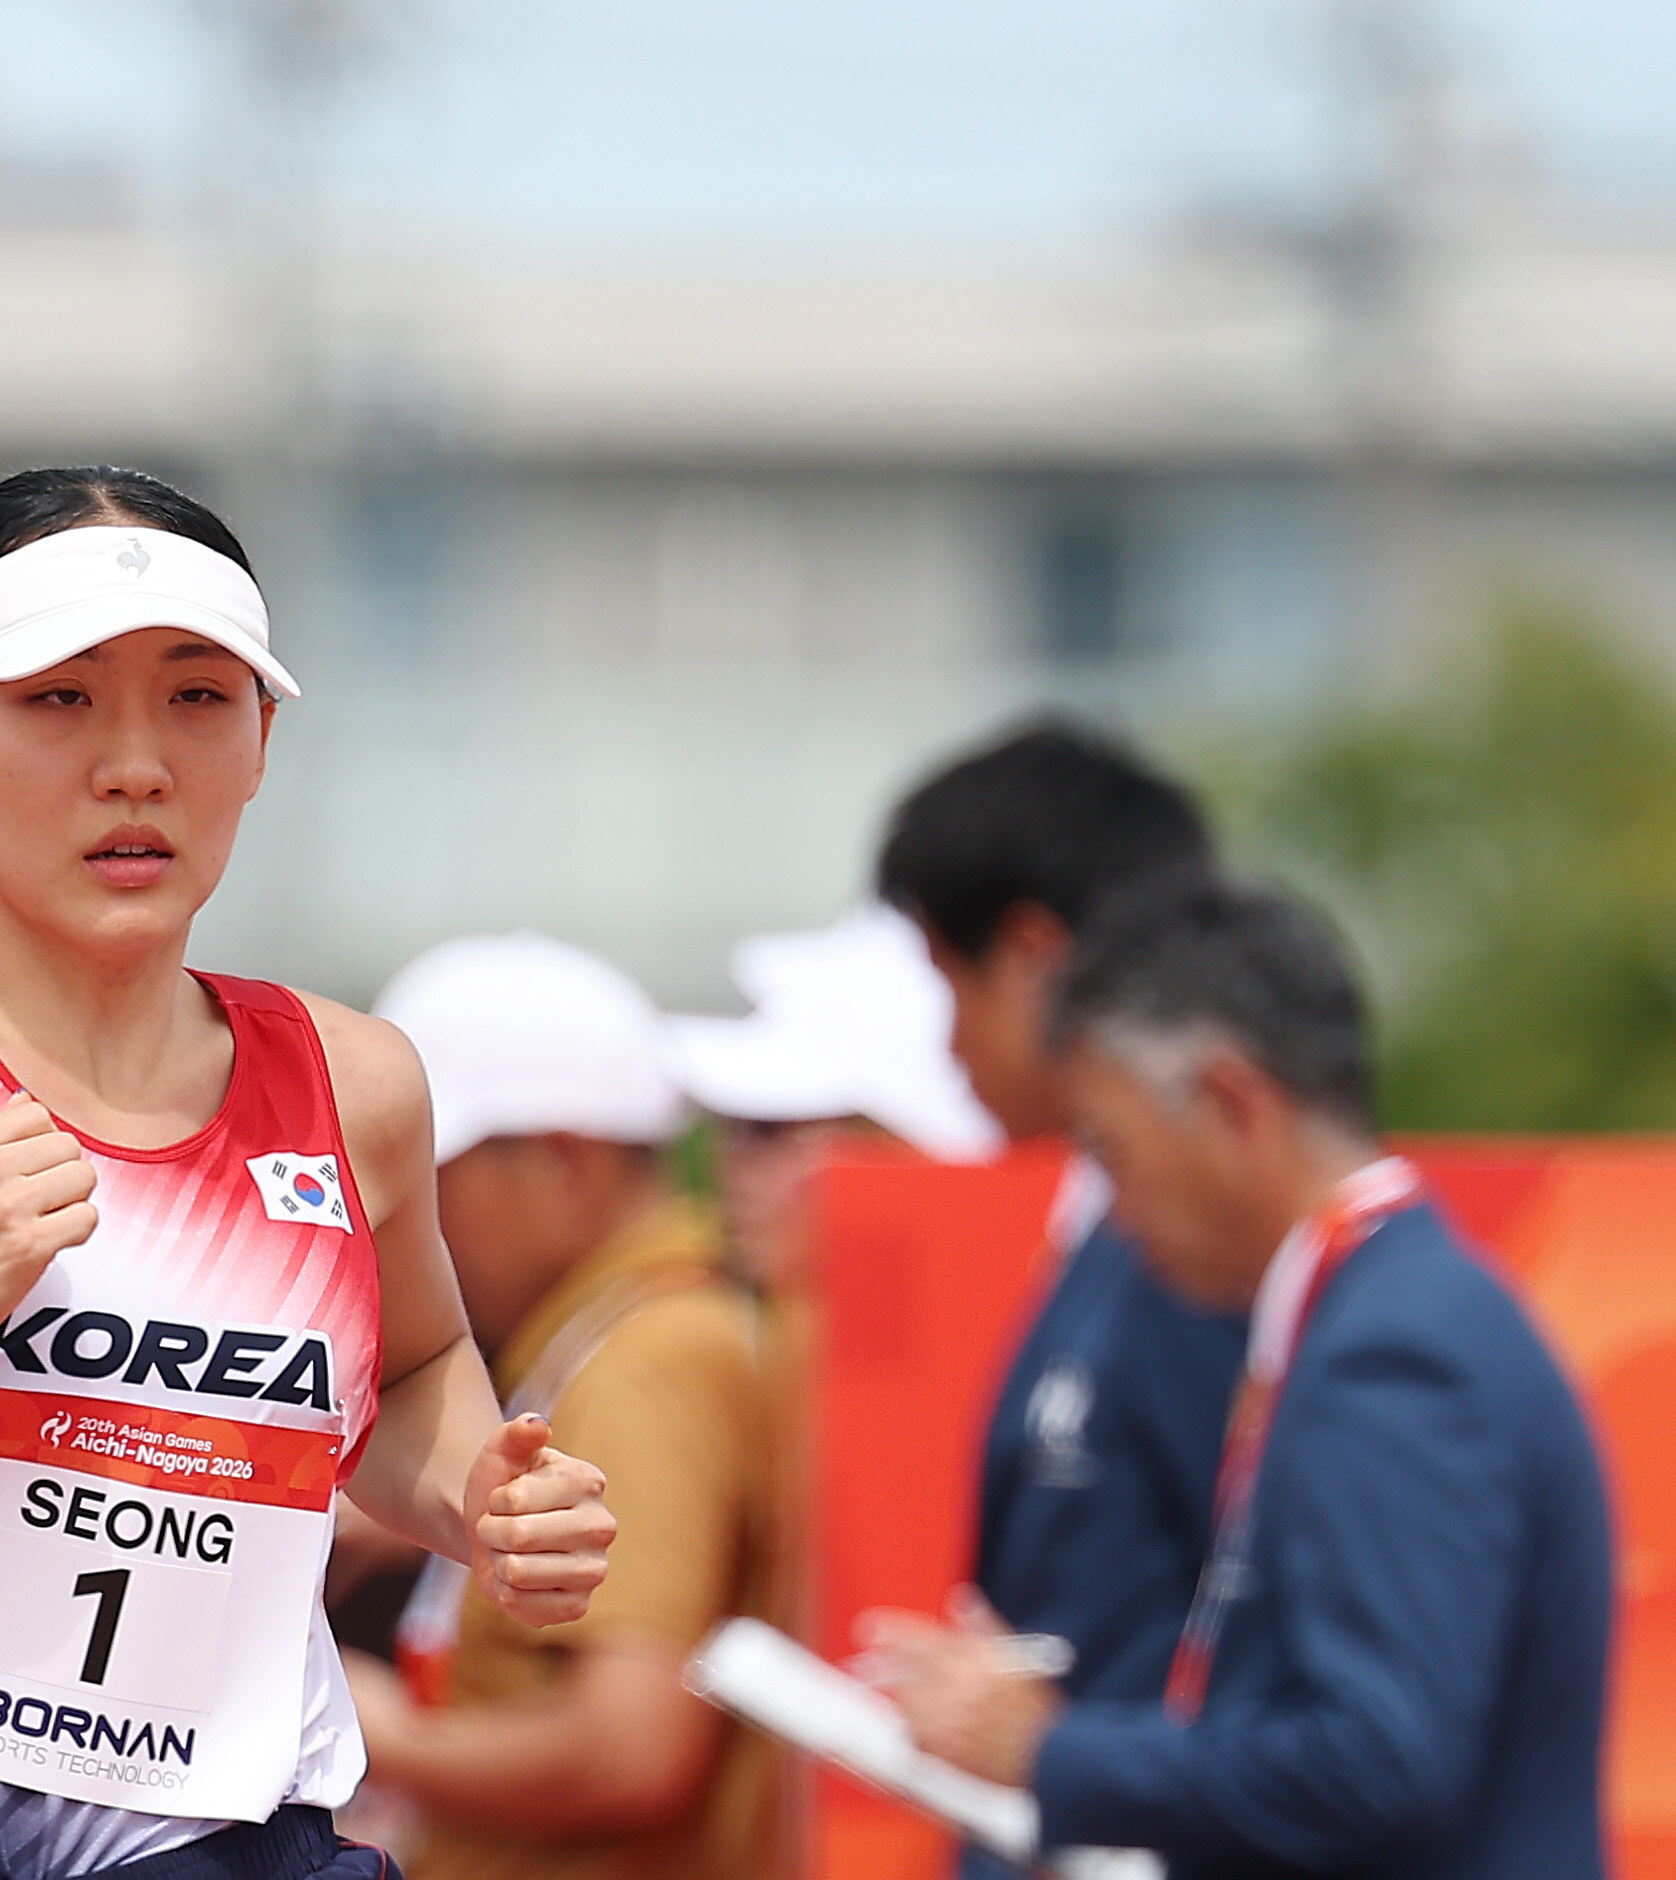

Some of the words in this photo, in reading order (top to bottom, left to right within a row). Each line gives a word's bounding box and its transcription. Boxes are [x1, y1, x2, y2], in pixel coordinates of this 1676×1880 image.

[70, 1431, 209, 1476] Aichi-Nagoya
[209, 1457, 254, 1480] 2026
[76, 1416, 115, 1435] 20th
[117, 1423, 163, 1445] Asian
[165, 1432, 213, 1453] Games
[20, 1478, 235, 1565] SEONG
[72, 1567, 132, 1686] 1
[56, 1750, 191, 1790] TECHNOLOGY
